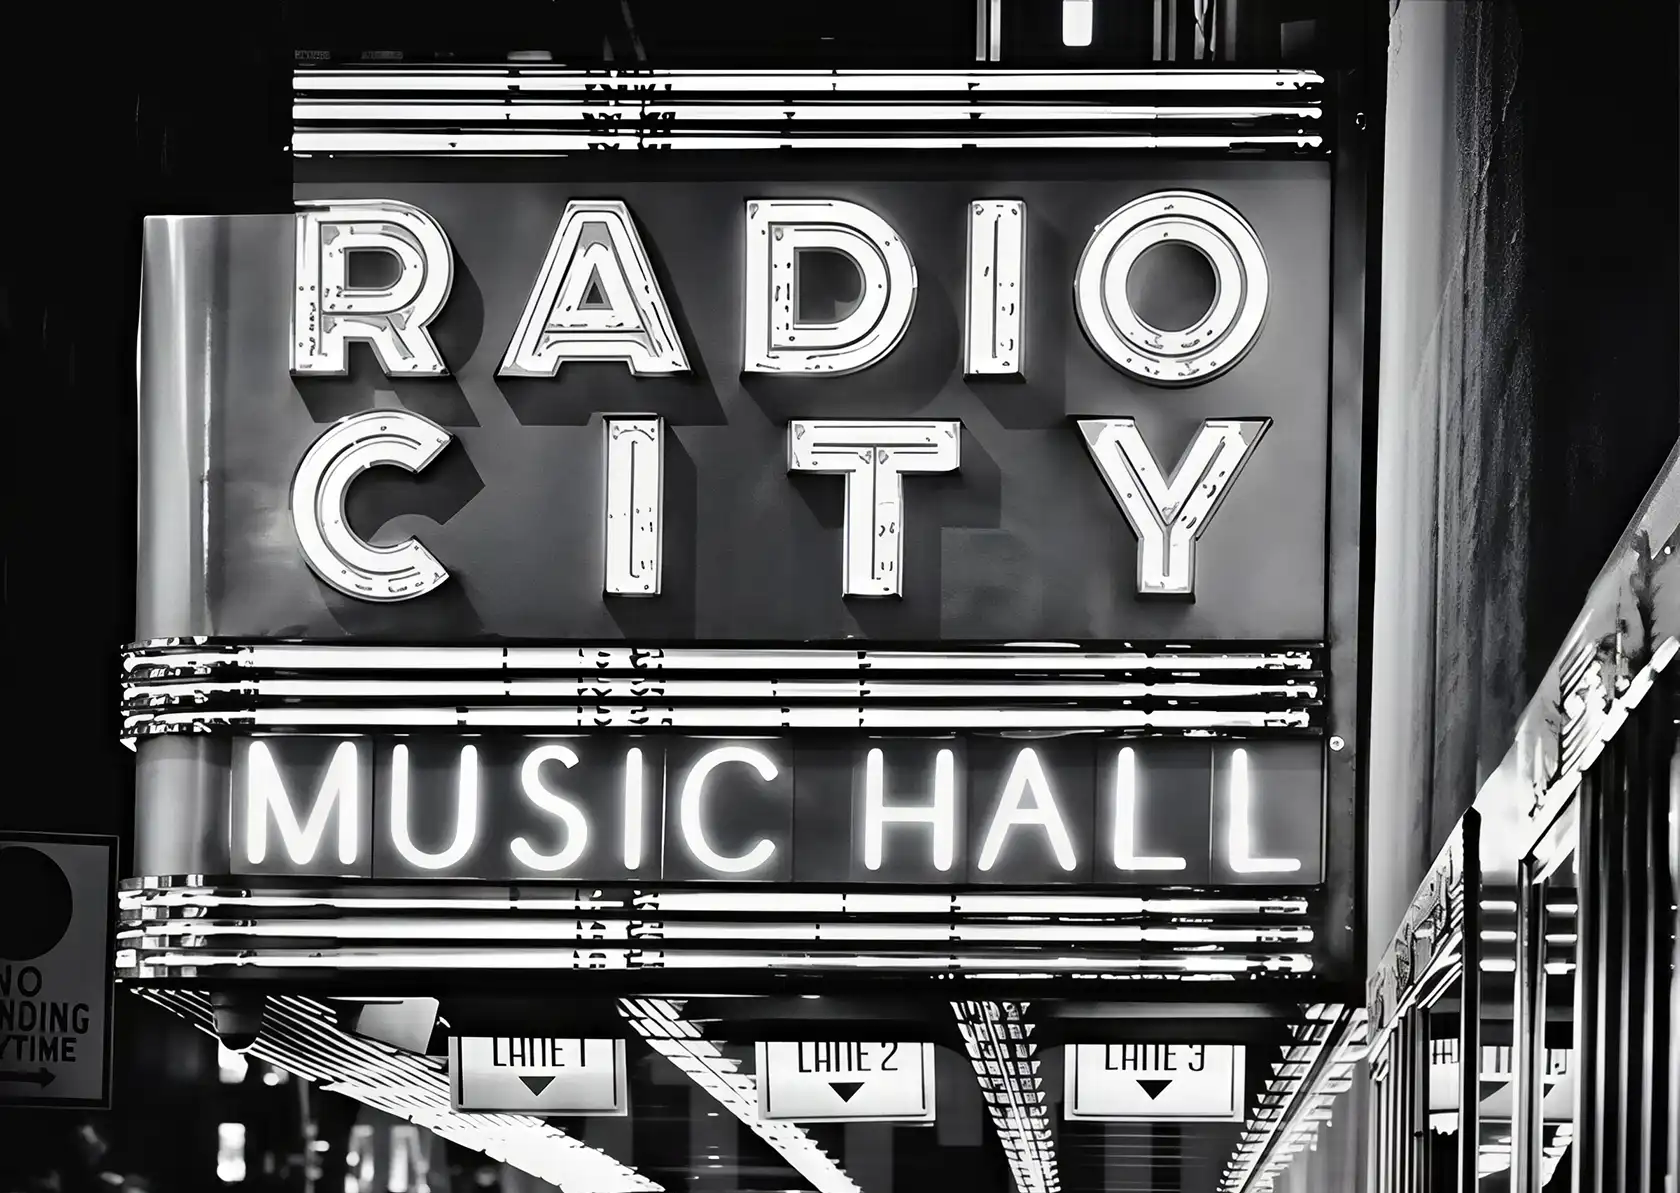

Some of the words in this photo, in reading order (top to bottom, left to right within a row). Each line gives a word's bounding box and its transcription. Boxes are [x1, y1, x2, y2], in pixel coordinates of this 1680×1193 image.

[289, 190, 1271, 388] RADIO
[289, 409, 1273, 602] CITY
[248, 741, 779, 872] MUSIC
[864, 747, 1301, 873] HALL
[881, 1042, 898, 1071] 2
[1188, 1044, 1205, 1072] 3
